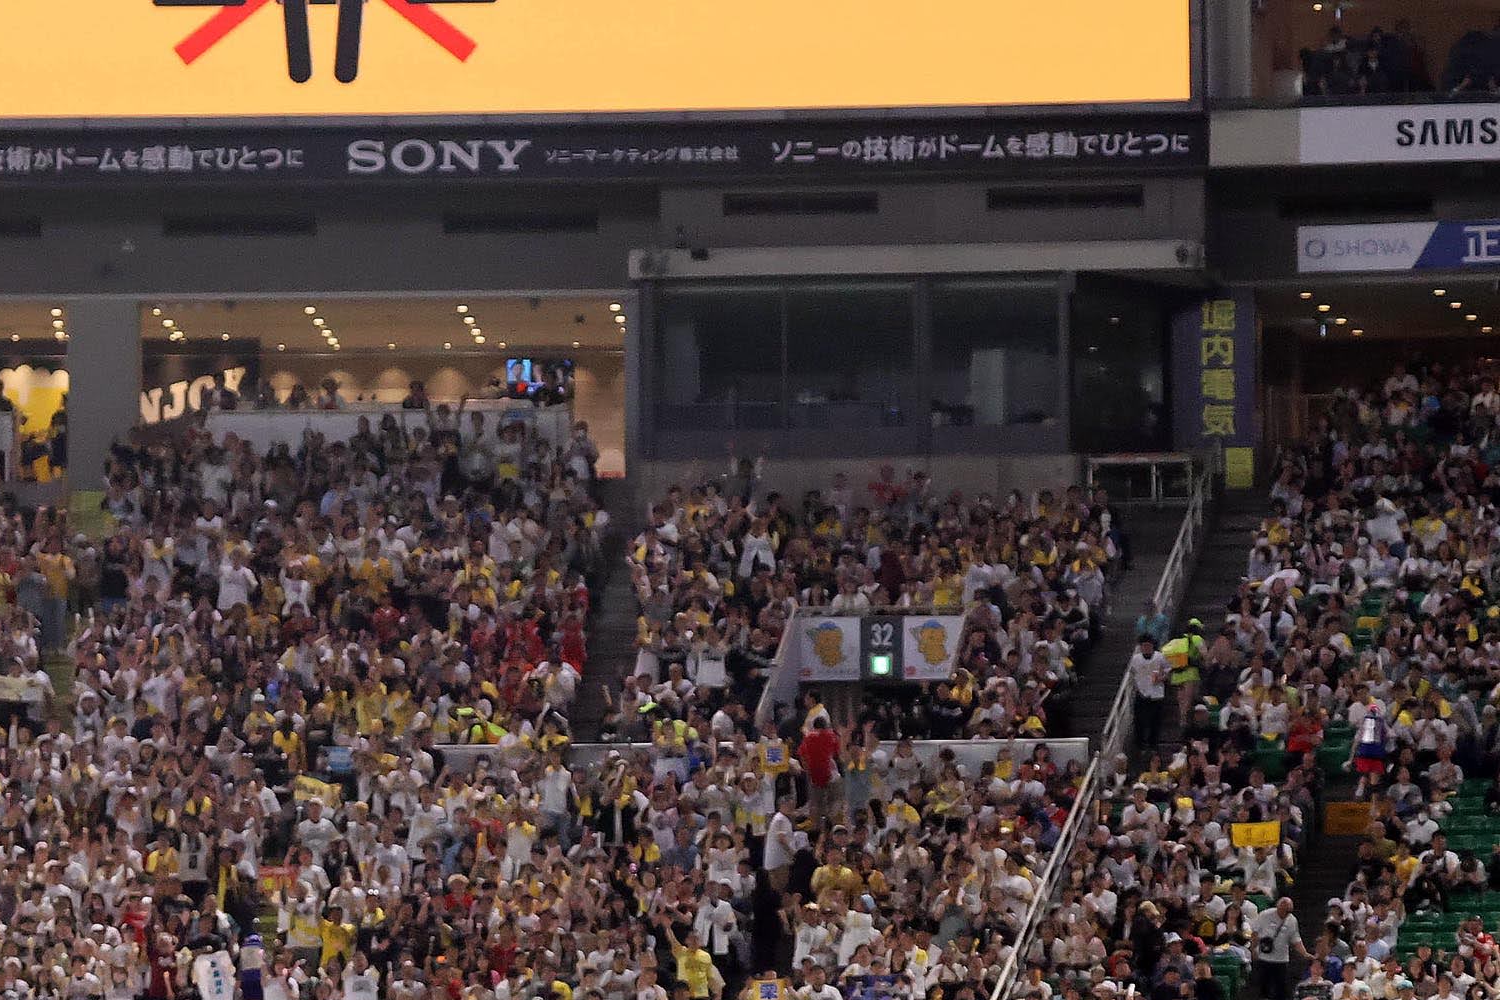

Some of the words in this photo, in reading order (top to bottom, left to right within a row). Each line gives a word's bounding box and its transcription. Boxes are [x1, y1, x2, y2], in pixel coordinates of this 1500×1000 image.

[1396, 118, 1500, 146] SAMS
[348, 139, 531, 173] SONY
[772, 132, 1189, 163] ソニーの技術がドームを感動でひとつに
[870, 622, 893, 647] 32
